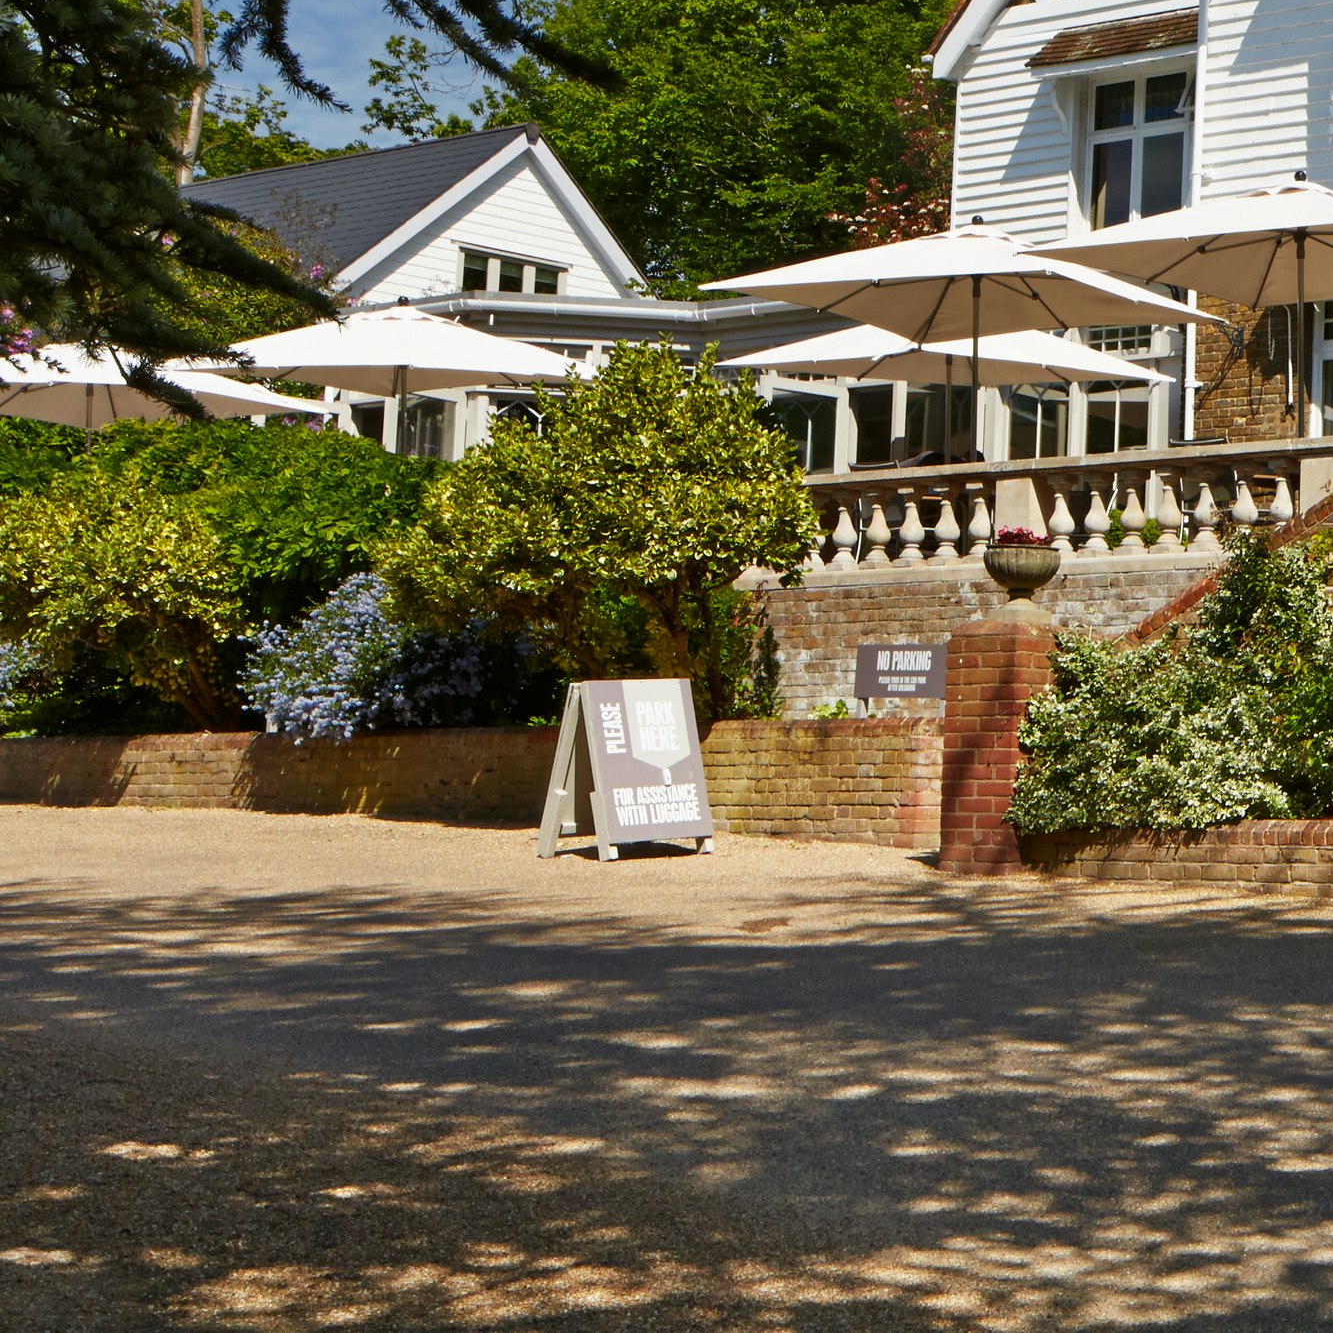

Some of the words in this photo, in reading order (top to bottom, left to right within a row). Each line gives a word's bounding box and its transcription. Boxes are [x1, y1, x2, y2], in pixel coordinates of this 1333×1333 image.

[877, 650, 891, 671] NO
[892, 650, 932, 671] PARKING
[635, 701, 675, 726] PARK
[600, 702, 626, 754] PLEASE
[639, 726, 680, 752] HERE
[613, 788, 635, 806] FOR
[637, 783, 698, 804] ASSISTANCE
[616, 804, 648, 826] WITH
[650, 802, 701, 823] LUGGAGE
